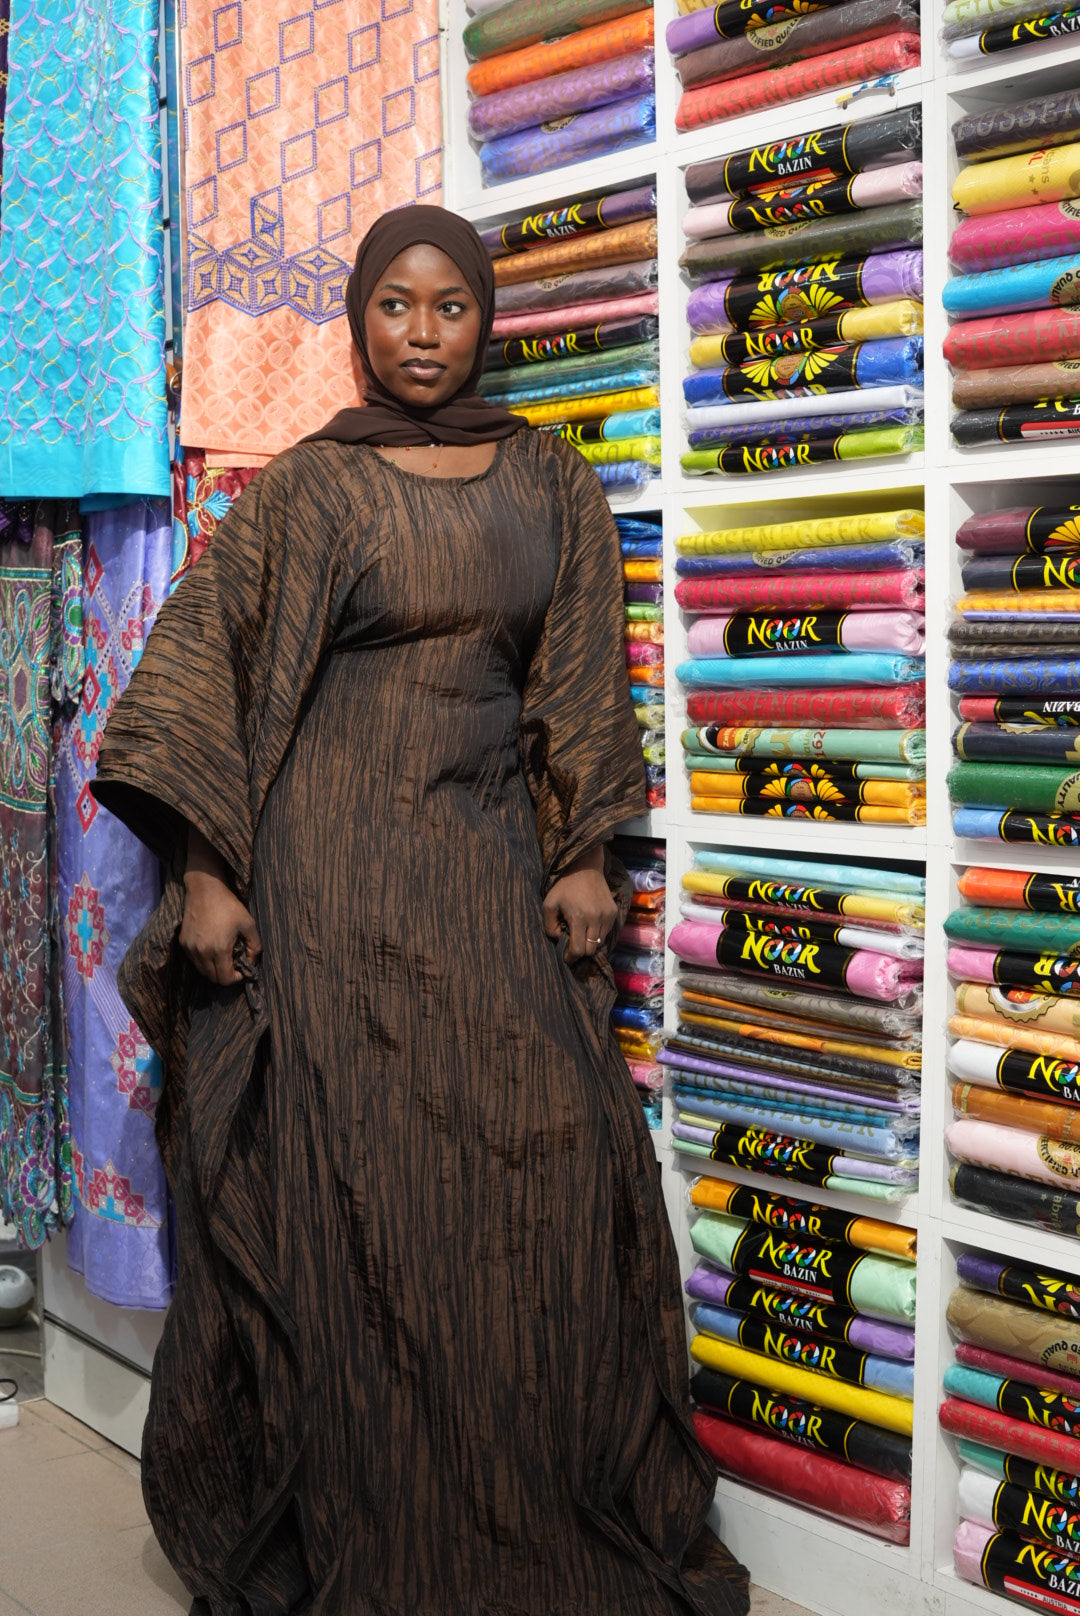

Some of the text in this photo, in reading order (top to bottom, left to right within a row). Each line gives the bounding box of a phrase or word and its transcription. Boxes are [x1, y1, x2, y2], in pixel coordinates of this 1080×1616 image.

[681, 48, 885, 128] FUSSENEGGER
[748, 132, 827, 174] NOOR
[777, 156, 812, 176] BAZIN
[521, 202, 587, 237] NOOR
[545, 224, 578, 239] BAZIN
[757, 260, 841, 292] NOOR
[519, 333, 588, 363] NOOR
[742, 327, 828, 359] NOOR
[742, 444, 815, 472] NOOR
[680, 516, 876, 553] FUSSENEGGER
[684, 576, 888, 607] FUSSENEGGER
[747, 616, 822, 649] NOOR
[775, 640, 809, 651] BAZIN
[688, 692, 889, 721] FUSSENEGGER
[812, 728, 826, 758] 162
[747, 880, 824, 910] NOOR
[741, 931, 821, 974] NOOR
[773, 964, 806, 979] BAZIN
[738, 1136, 815, 1171] NOOR
[751, 1194, 827, 1240] NOOR
[758, 1228, 832, 1278] NOOR
[783, 1263, 817, 1282] BAZIN
[750, 1287, 828, 1328] NOOR
[779, 1312, 813, 1332] BAZIN
[763, 1323, 842, 1378] NOOR
[751, 1389, 829, 1448] NOOR
[1042, 1595, 1068, 1610] AUSTRIA
